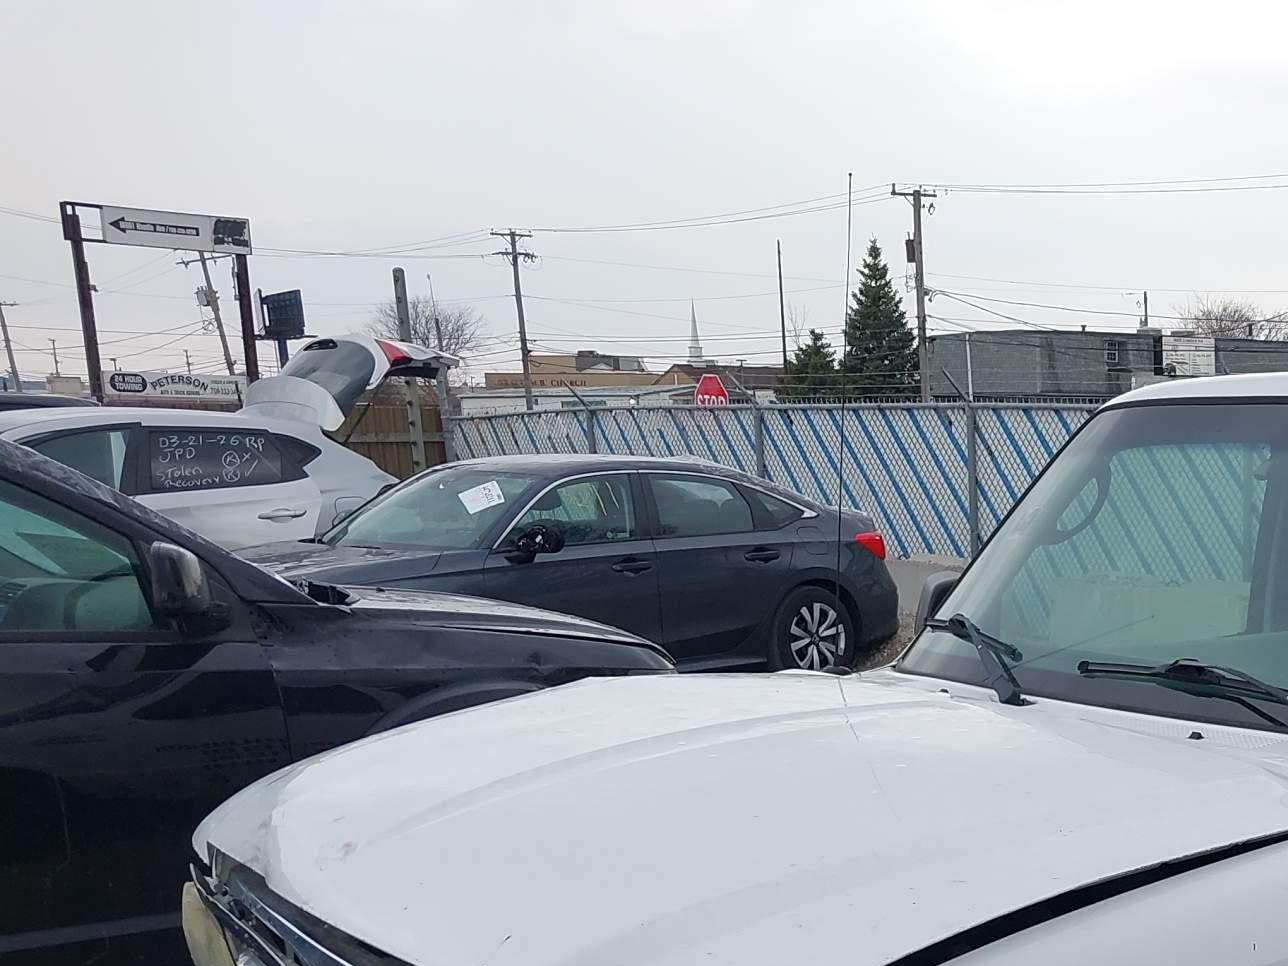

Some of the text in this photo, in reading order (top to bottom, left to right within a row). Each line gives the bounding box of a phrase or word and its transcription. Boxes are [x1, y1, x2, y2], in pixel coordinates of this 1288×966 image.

[125, 375, 142, 383] HOUR
[149, 375, 209, 392] PETERSON
[115, 382, 143, 391] TOWING
[697, 395, 726, 406] STOP
[159, 447, 195, 463] JPD
